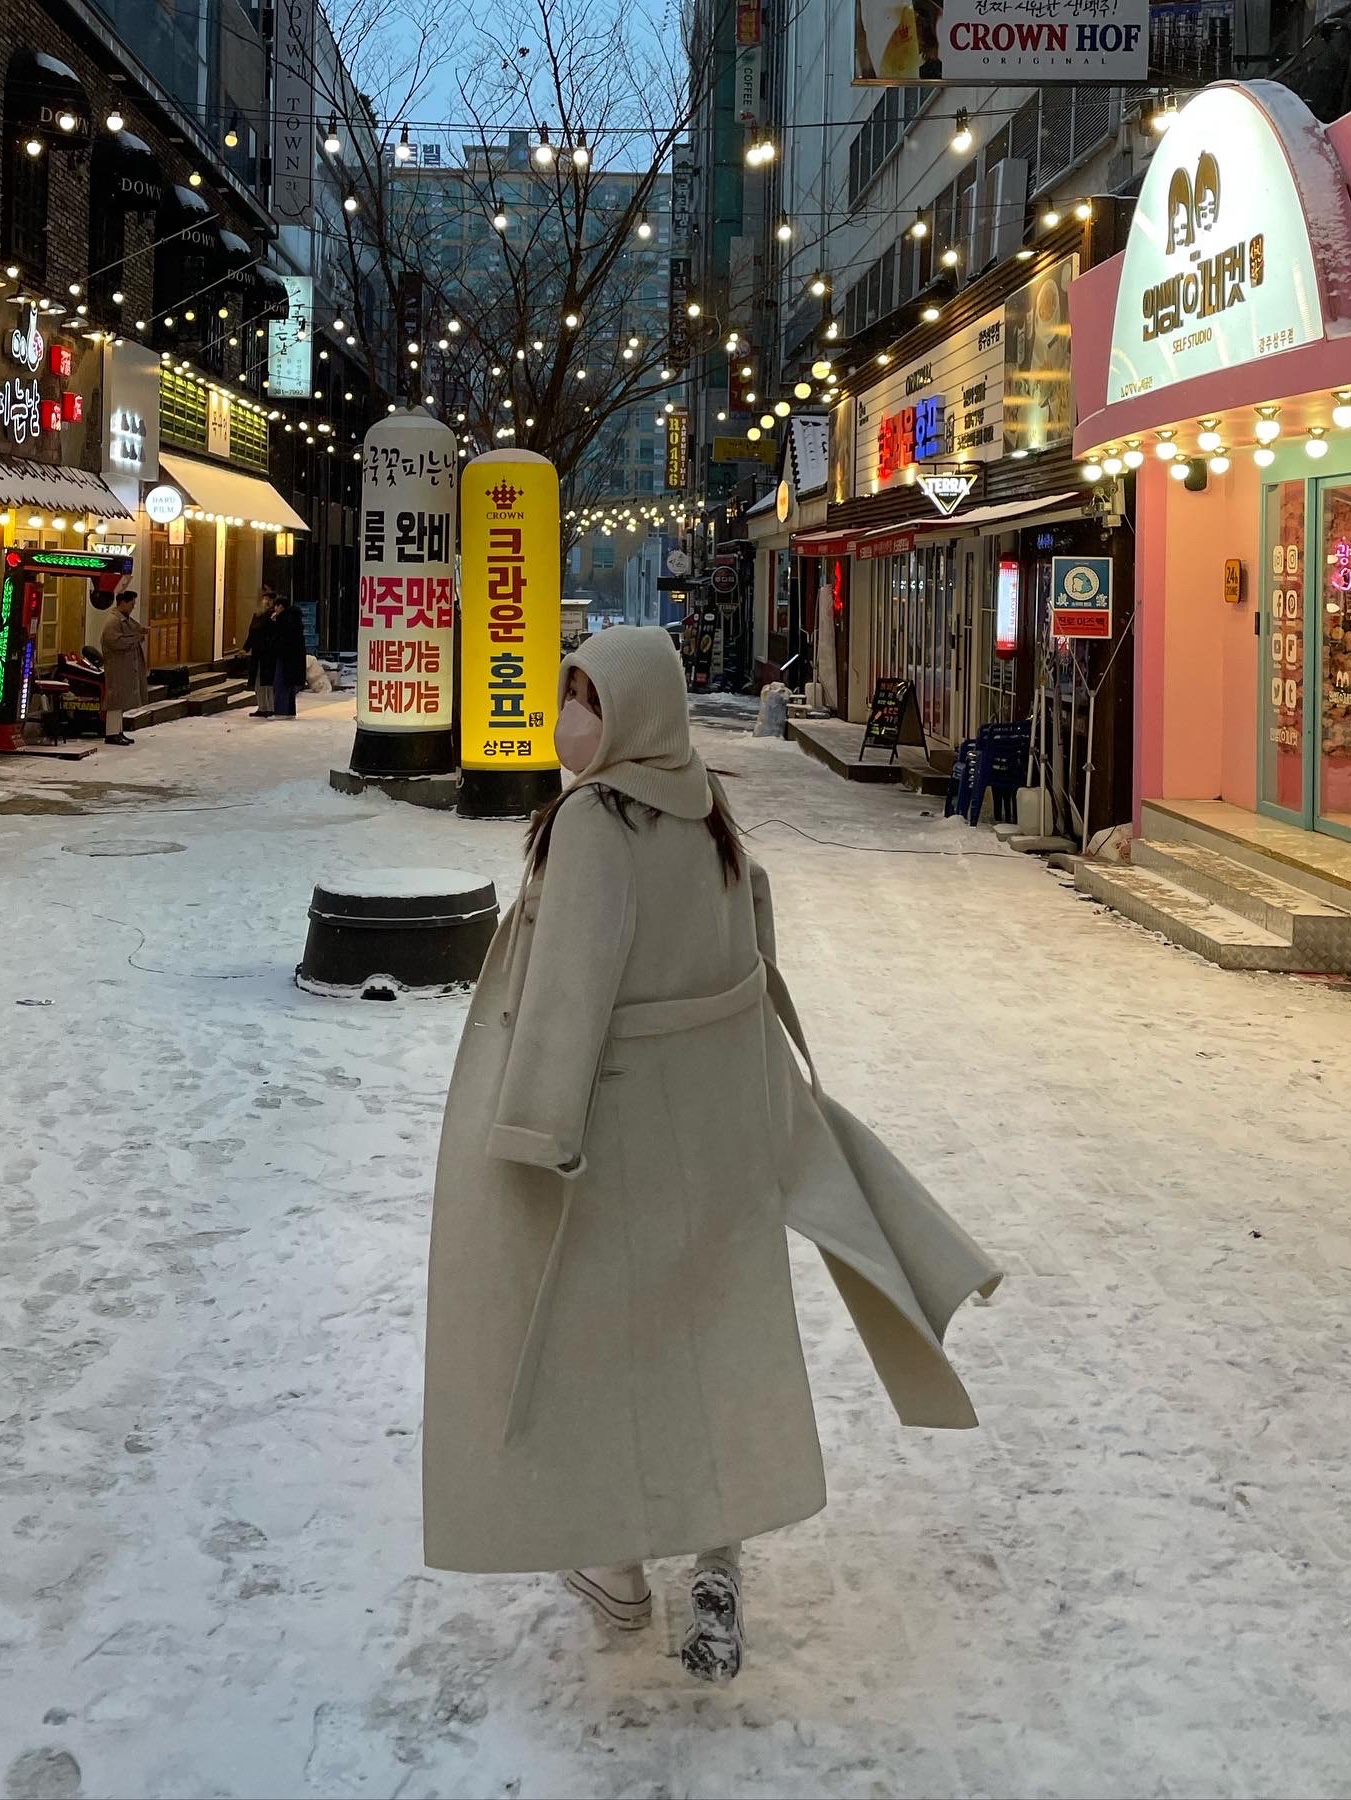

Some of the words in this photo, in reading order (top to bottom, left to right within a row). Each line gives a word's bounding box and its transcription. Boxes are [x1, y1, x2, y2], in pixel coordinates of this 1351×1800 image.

[975, 0, 1011, 15] 진짜
[1015, 0, 1060, 17] 시원한
[1064, 0, 1118, 18] 생맥주!
[286, 5, 302, 79] DOWN
[950, 23, 1069, 52] CROWN
[1075, 24, 1142, 52] HOF
[982, 57, 1107, 65] ORIGINAL
[744, 67, 753, 105] COFFEE
[284, 97, 303, 170] TOWN
[121, 177, 163, 201] DOWN
[1172, 337, 1187, 355] SELF
[1188, 328, 1213, 349] STUDIO
[1258, 328, 1295, 353] 광주상무점
[924, 477, 970, 495] TERRA
[486, 511, 524, 520] CROWN
[96, 544, 129, 555] TERRA
[365, 511, 385, 562] 룸
[396, 511, 451, 564] 완비
[487, 528, 527, 643] 크라운
[360, 576, 453, 629] 안주맛집
[368, 640, 440, 673] 배달가능
[368, 680, 440, 714] 단체가능
[488, 652, 527, 728] 호프
[483, 740, 532, 757] 상무점
